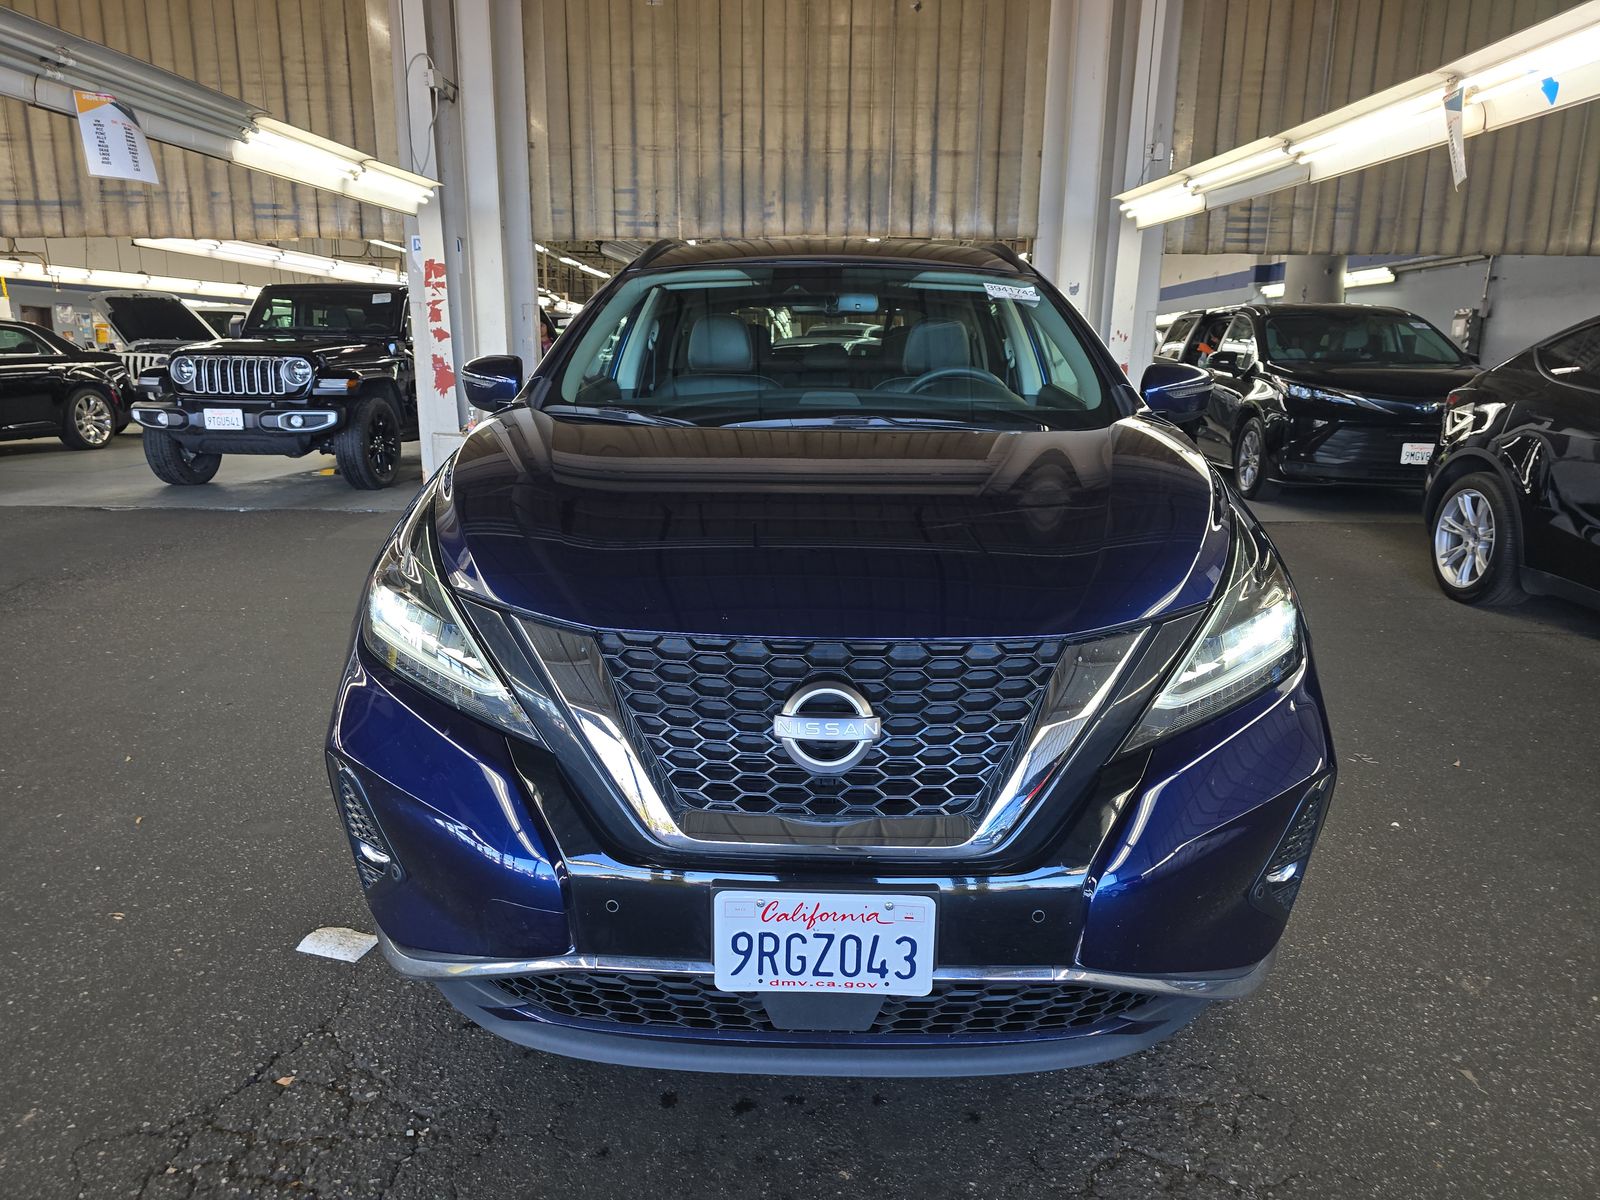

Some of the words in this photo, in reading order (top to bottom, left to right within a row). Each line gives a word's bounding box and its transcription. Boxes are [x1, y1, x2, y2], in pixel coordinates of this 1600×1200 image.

[1404, 451, 1431, 461] 9MGV8
[777, 720, 878, 736] NISSAN
[761, 900, 895, 930] California
[730, 931, 918, 980] 9RGZ043
[769, 978, 878, 988] dmv.ca.gov
